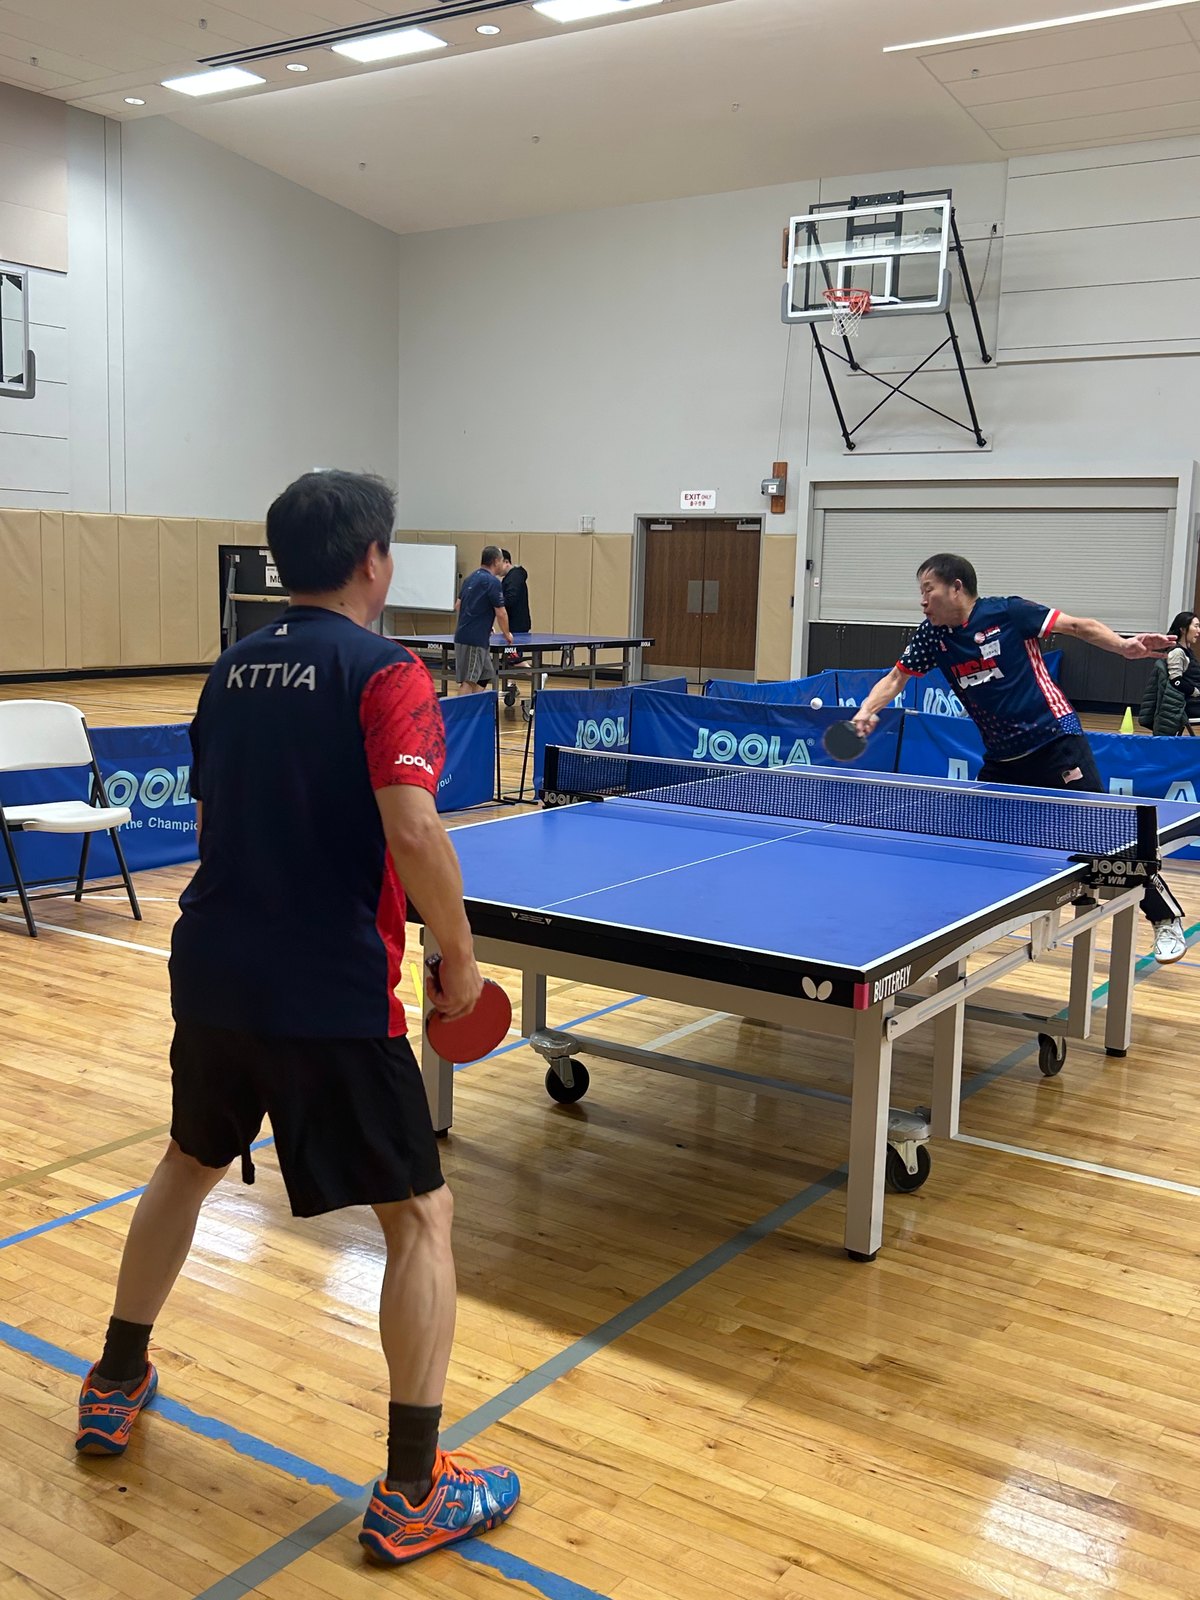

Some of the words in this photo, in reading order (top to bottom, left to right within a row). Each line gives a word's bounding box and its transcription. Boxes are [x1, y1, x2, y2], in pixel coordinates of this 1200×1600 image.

[226, 662, 316, 691] KTTVA
[575, 716, 629, 749] JOOL
[394, 754, 434, 776] JOOLA
[1091, 859, 1147, 877] JOOLA
[1107, 876, 1127, 885] WM
[874, 964, 912, 1004] BUTTERFLY
